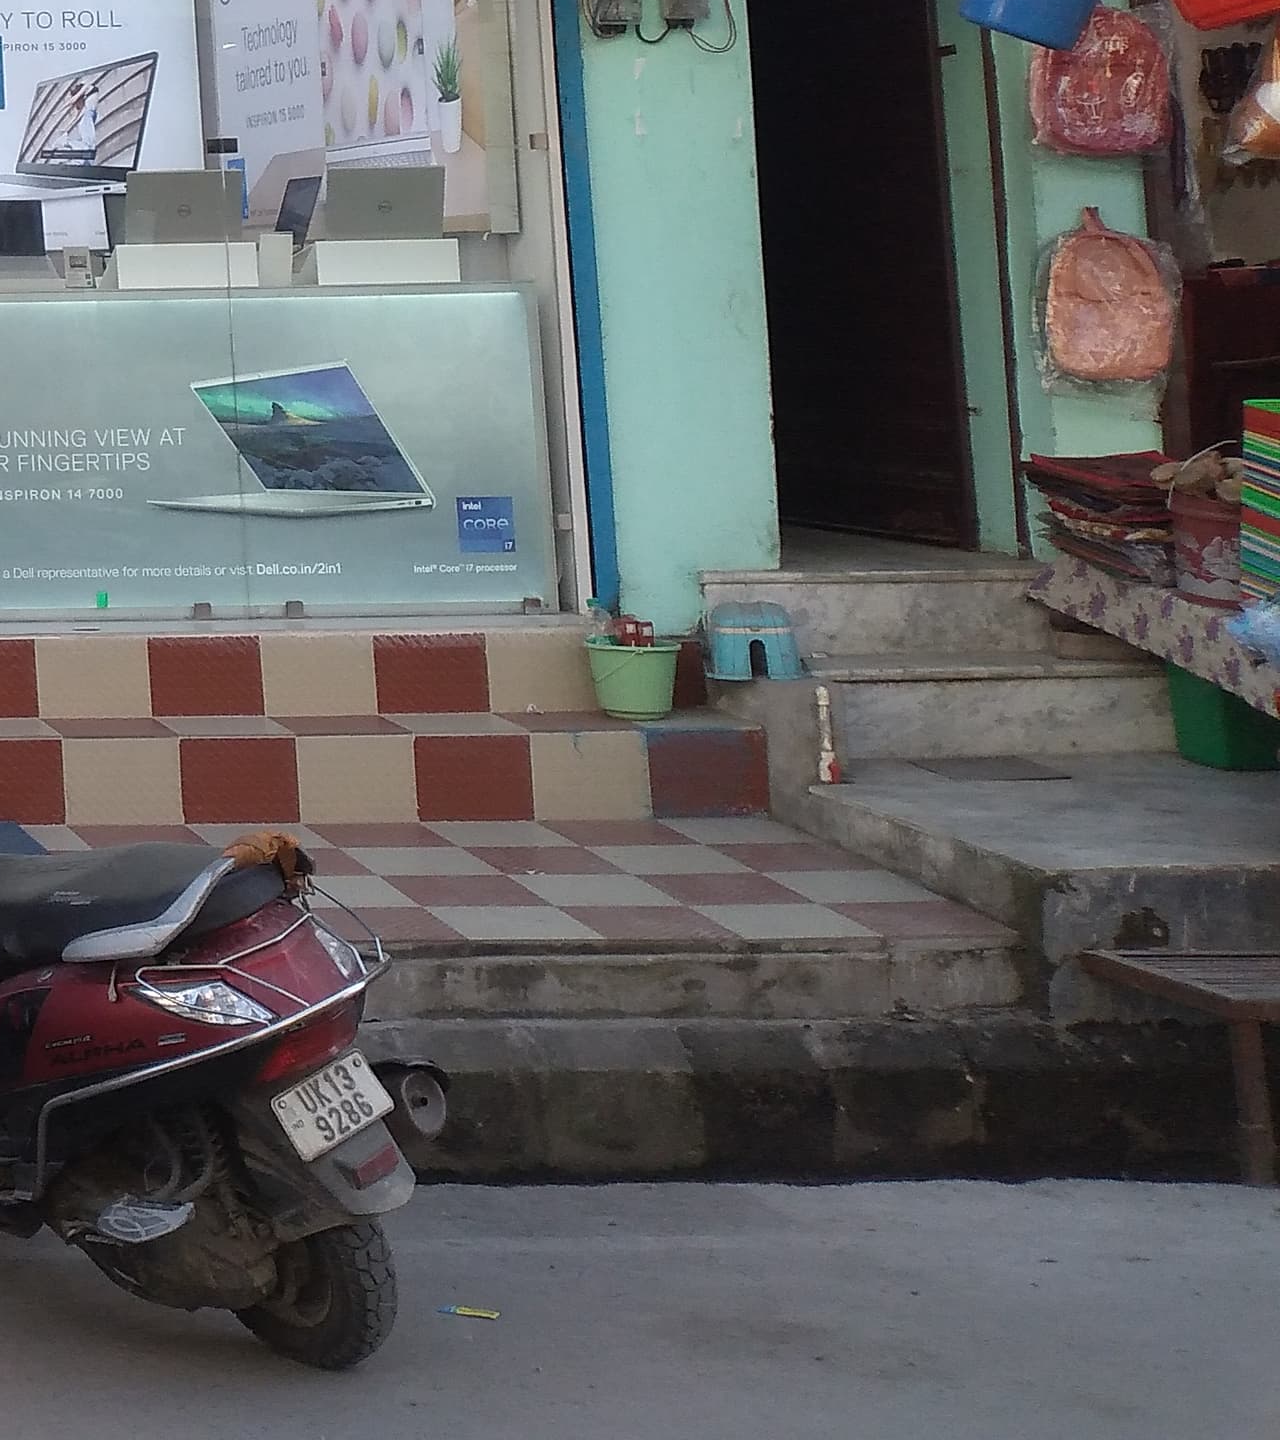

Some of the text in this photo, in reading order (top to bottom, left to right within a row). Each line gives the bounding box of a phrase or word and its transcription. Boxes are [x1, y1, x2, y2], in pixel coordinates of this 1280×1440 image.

[20, 10, 54, 30] TO
[60, 9, 122, 29] ROLL
[240, 16, 298, 53] Technology
[3, 42, 87, 52] PIRON 15 3000
[235, 60, 272, 92] tailored
[274, 59, 285, 83] to
[94, 428, 151, 447] VIEW
[159, 427, 187, 446] AT
[17, 452, 152, 473] FINGERTIPS
[67, 488, 83, 500] 14
[88, 487, 125, 500] 7000
[13, 566, 34, 579] Dell
[37, 565, 120, 582] representative
[122, 565, 139, 578] for
[142, 567, 172, 578] more
[175, 565, 211, 578] details
[214, 566, 227, 577] or
[256, 562, 343, 577] Dell.co.in/2in1
[476, 563, 518, 574] processor
[294, 1064, 357, 1115] UK13
[314, 1093, 374, 1142] 9286
